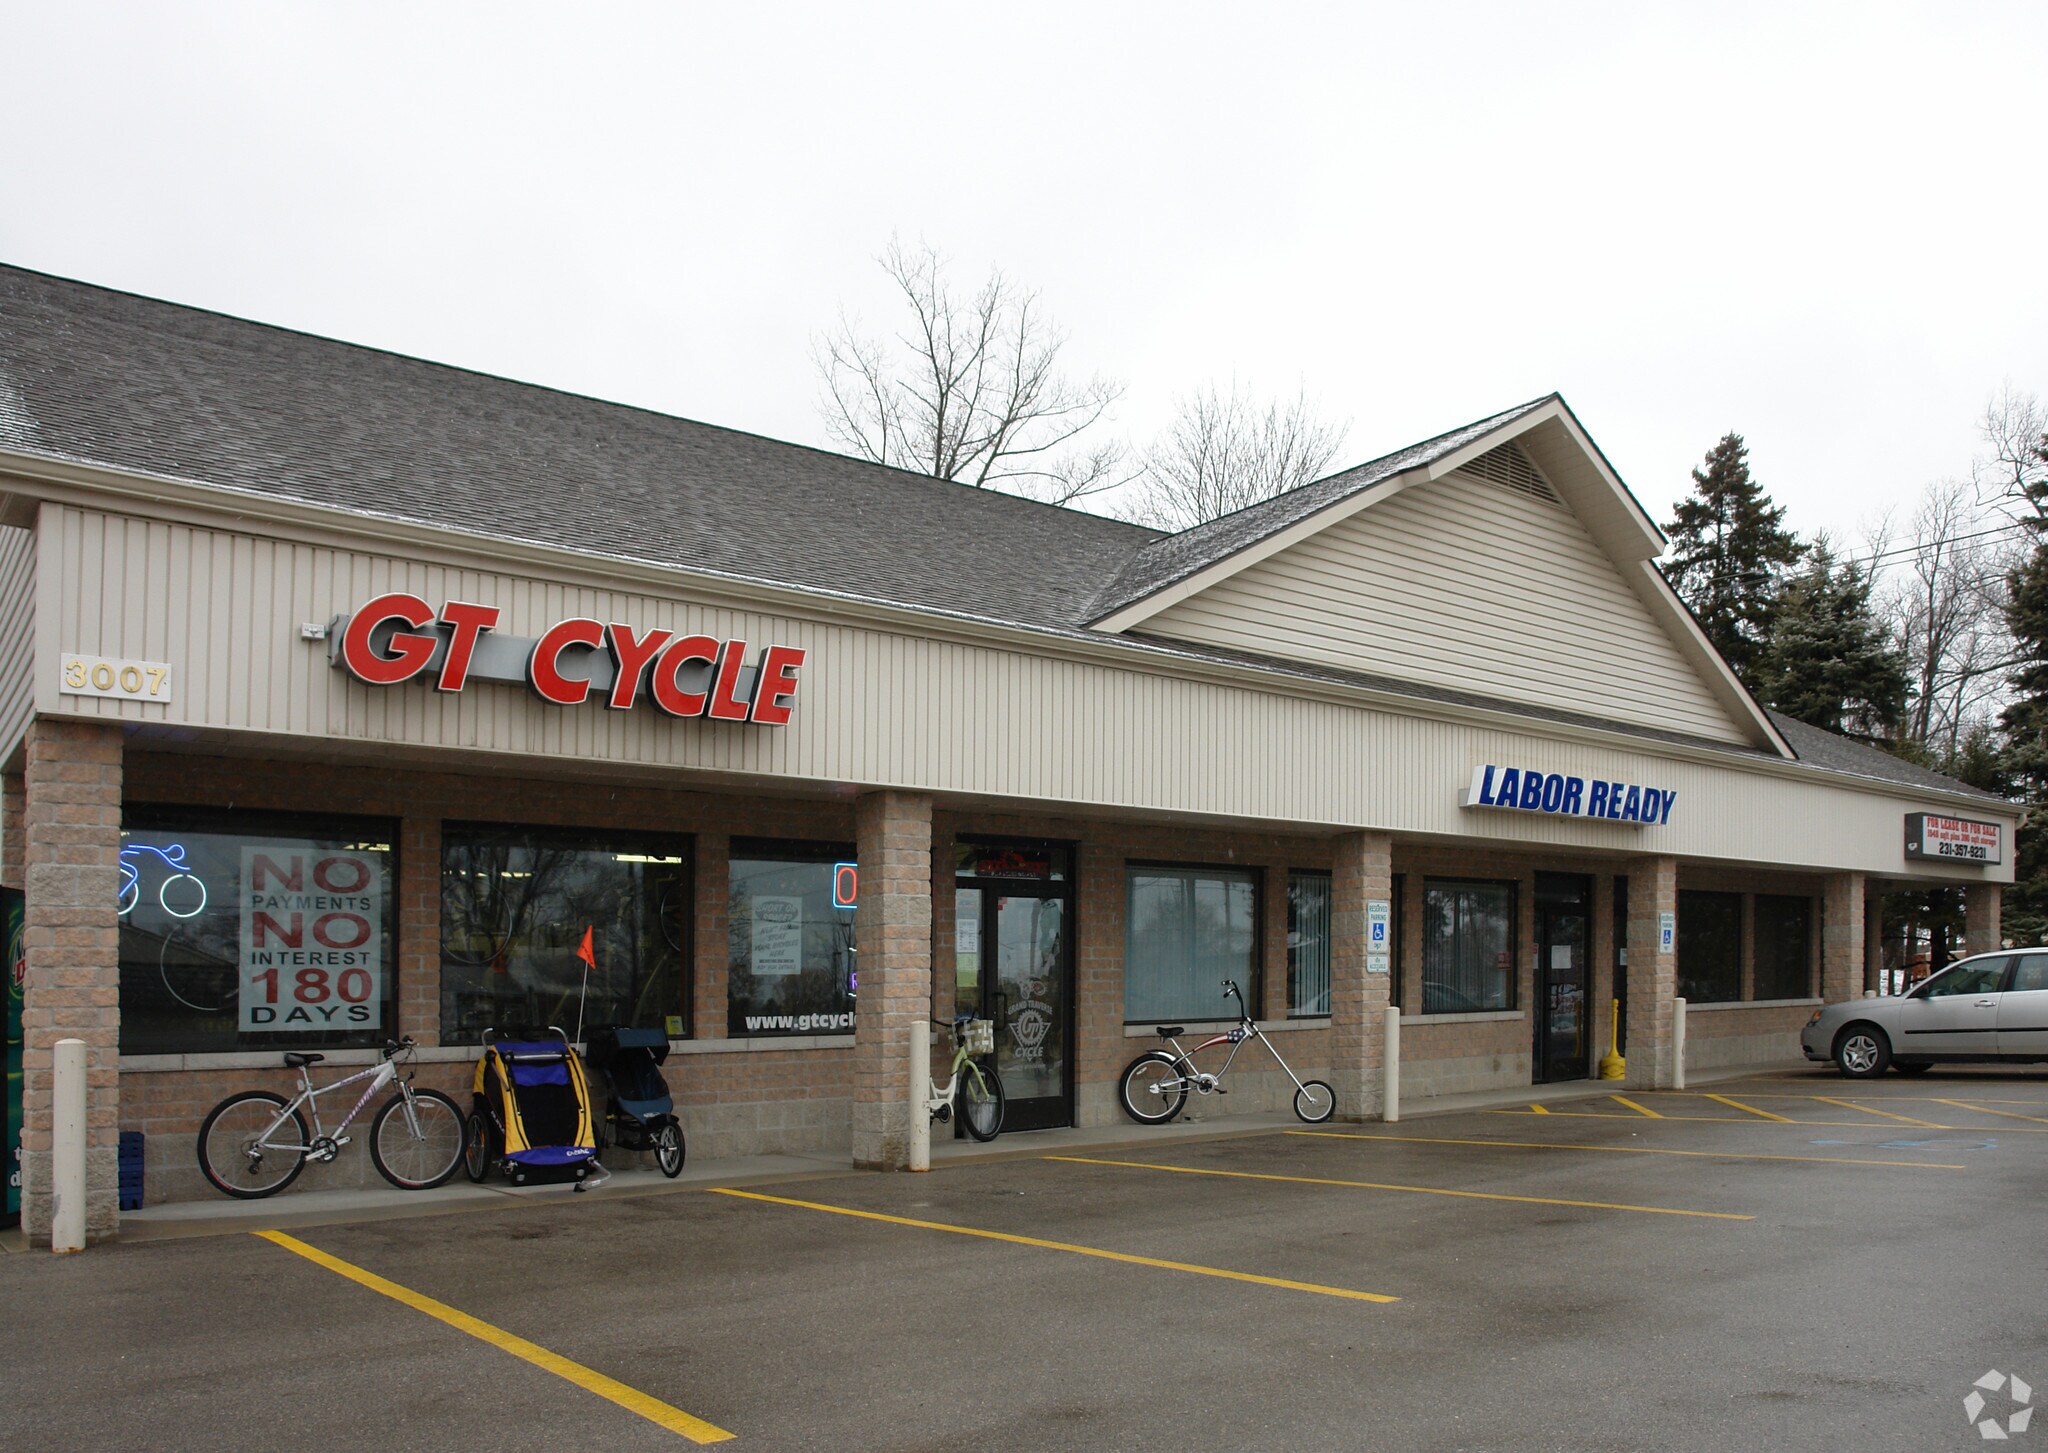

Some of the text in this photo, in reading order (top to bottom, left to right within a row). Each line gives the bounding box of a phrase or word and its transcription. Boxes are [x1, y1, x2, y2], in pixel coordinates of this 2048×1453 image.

[342, 592, 806, 726] GT CYCLE
[66, 660, 167, 695] 3007
[1478, 765, 1677, 825] LABOR READY
[1927, 816, 1996, 836] FOR LEASE OR FOR SALE
[1939, 842, 1986, 859] 231-357-9231
[252, 854, 371, 893] NO
[252, 895, 371, 910] PAYMENTS
[252, 911, 371, 949] NO
[252, 951, 371, 965] INTEREST
[251, 968, 372, 1004] 180
[251, 1005, 370, 1023] DAYS
[1008, 1000, 1053, 1015] GRAND TRAVERSE
[1015, 1047, 1043, 1057] CYCLE
